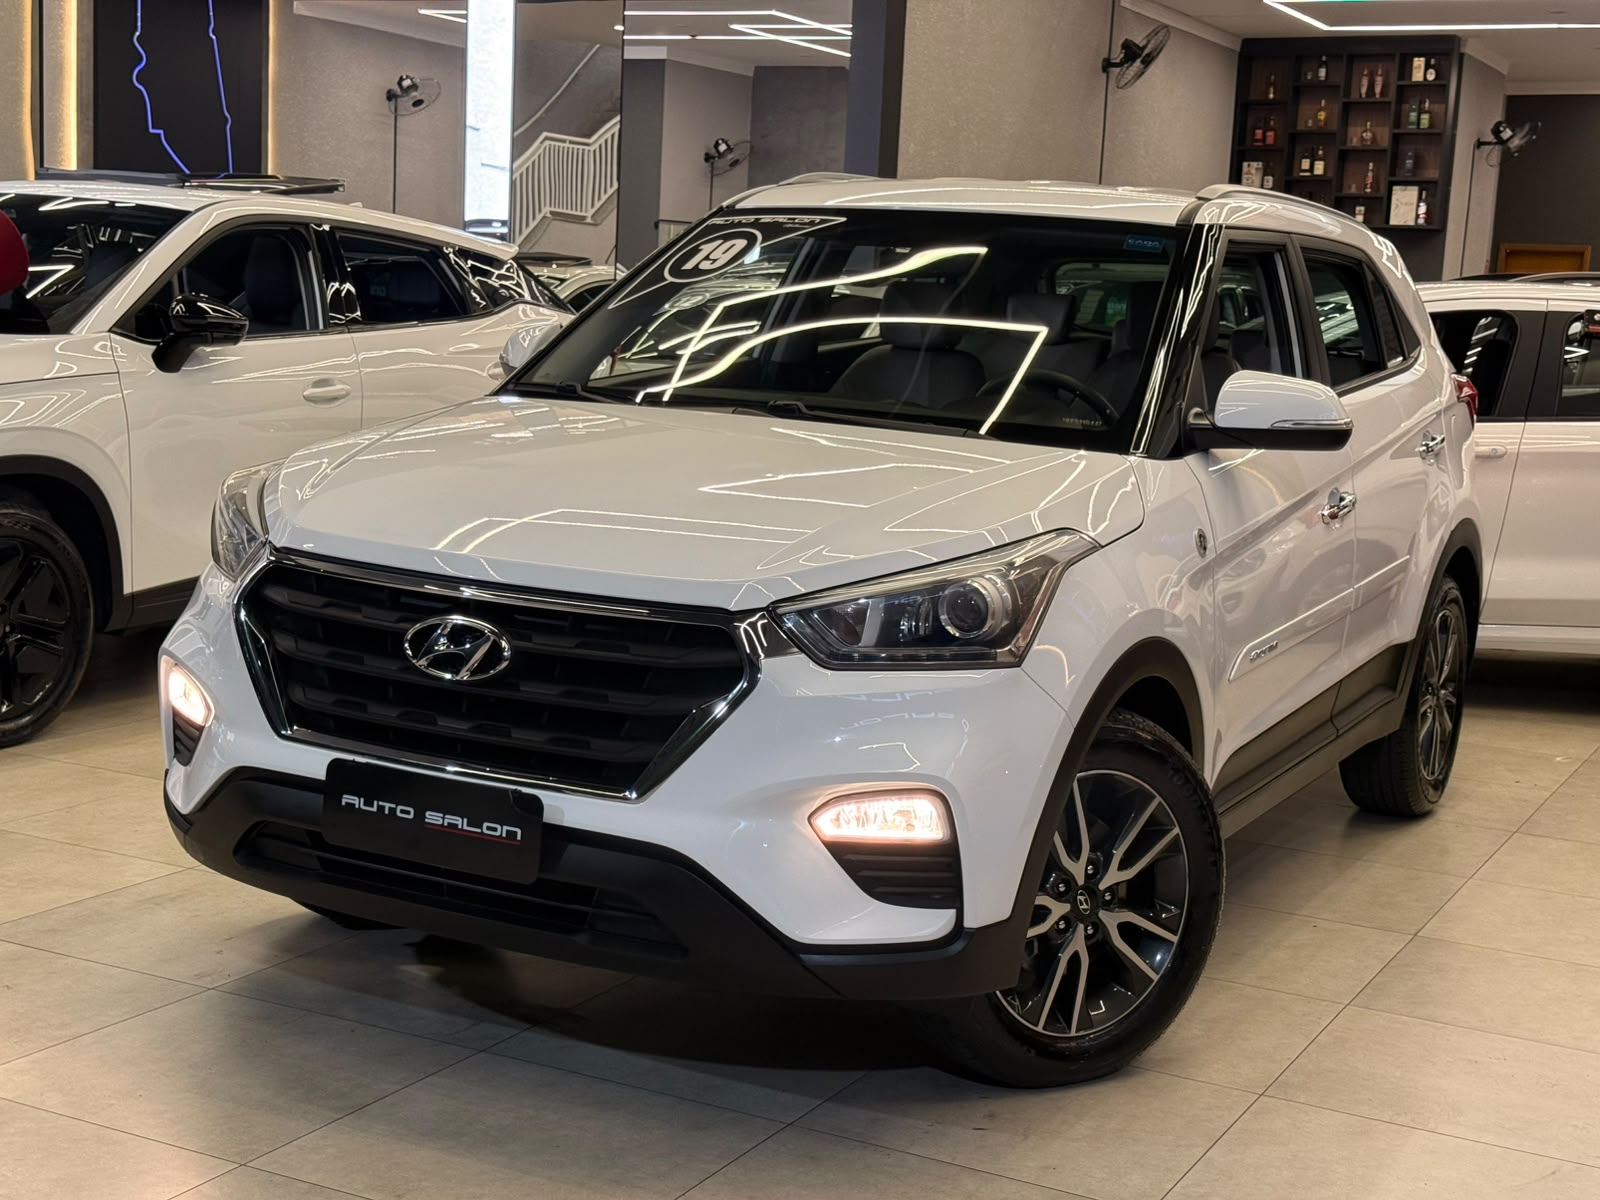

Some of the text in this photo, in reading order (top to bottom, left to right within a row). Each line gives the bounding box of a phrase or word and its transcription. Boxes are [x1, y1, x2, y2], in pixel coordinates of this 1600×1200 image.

[708, 217, 755, 226] AUTO
[681, 238, 748, 270] 19
[341, 794, 522, 841] AUTO SALON
